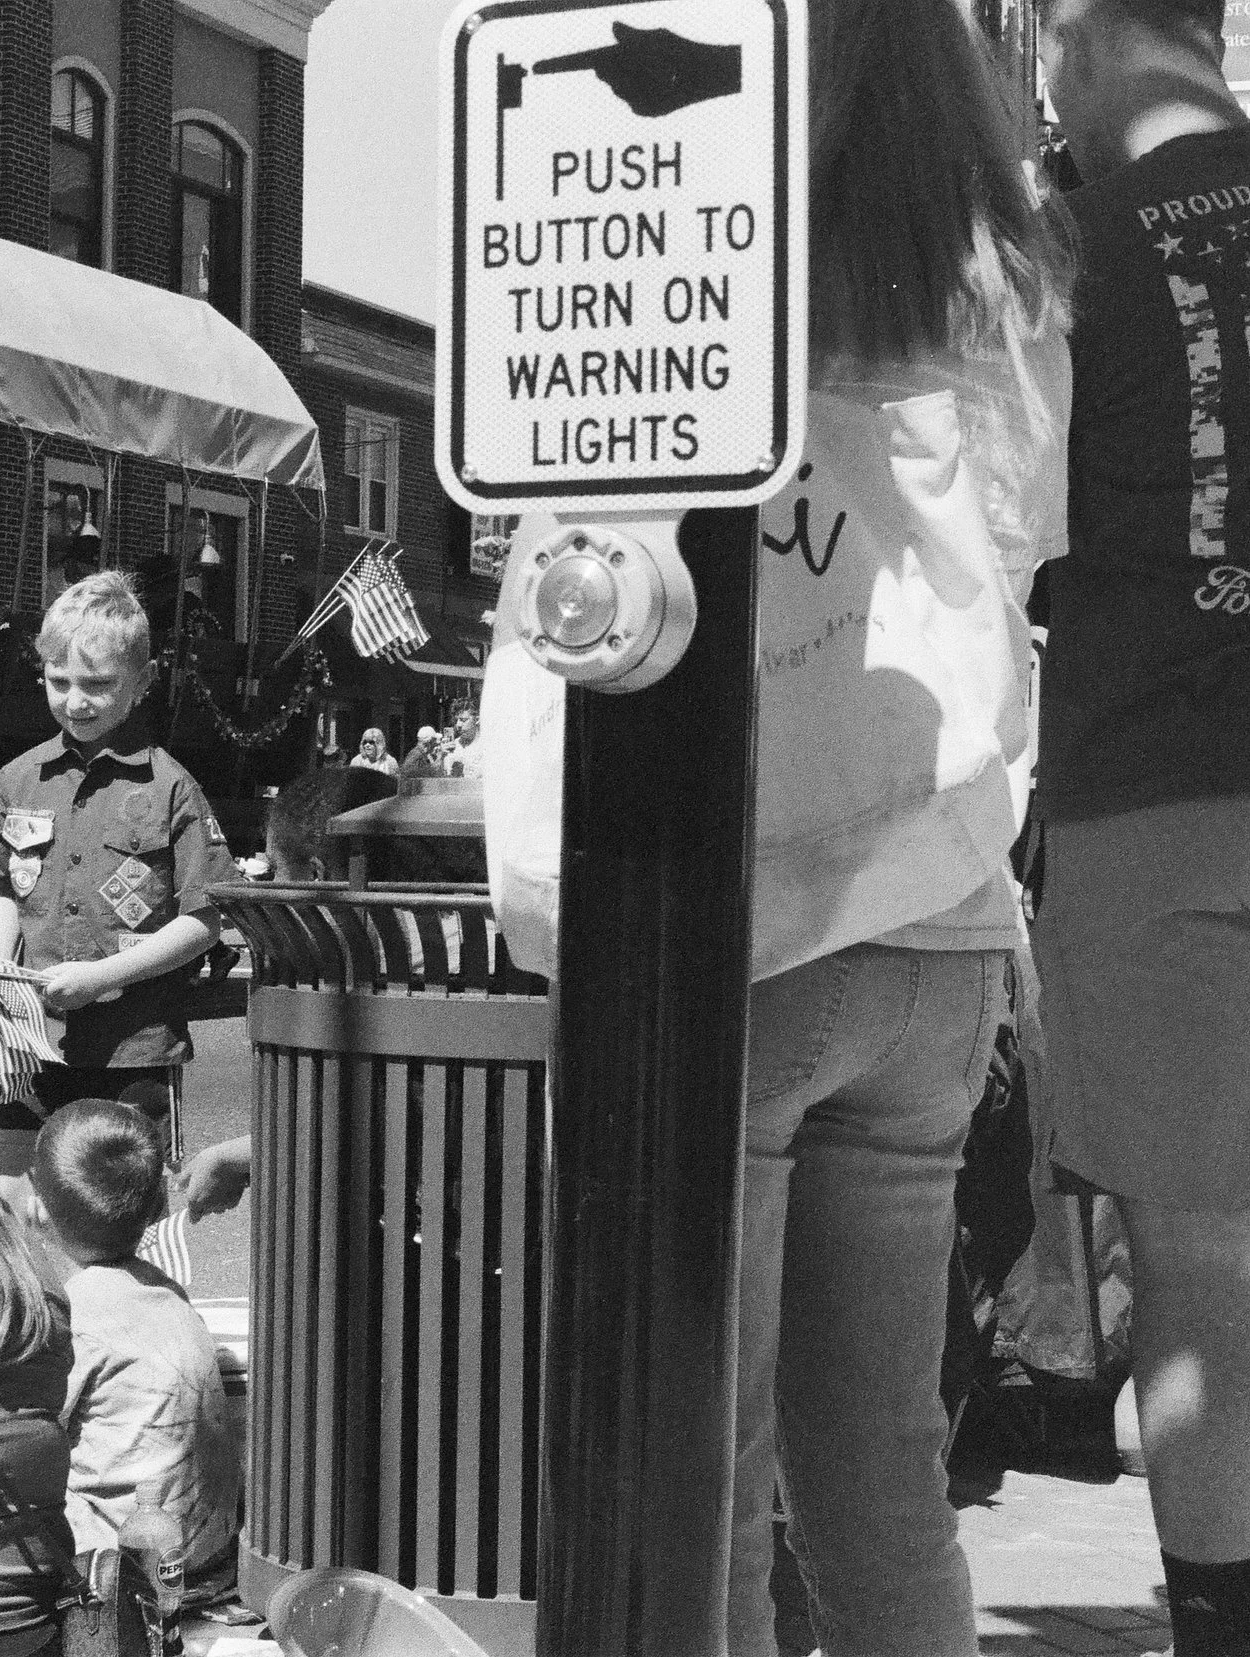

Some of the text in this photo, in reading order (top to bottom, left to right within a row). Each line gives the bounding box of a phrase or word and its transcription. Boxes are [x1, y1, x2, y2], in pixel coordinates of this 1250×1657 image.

[553, 142, 681, 197] PUSH
[483, 204, 755, 269] BUTTON TO
[1137, 186, 1250, 231] PROUD
[508, 275, 729, 333] TURN ON
[506, 343, 730, 400] WARNING
[532, 414, 699, 466] LIGHTS
